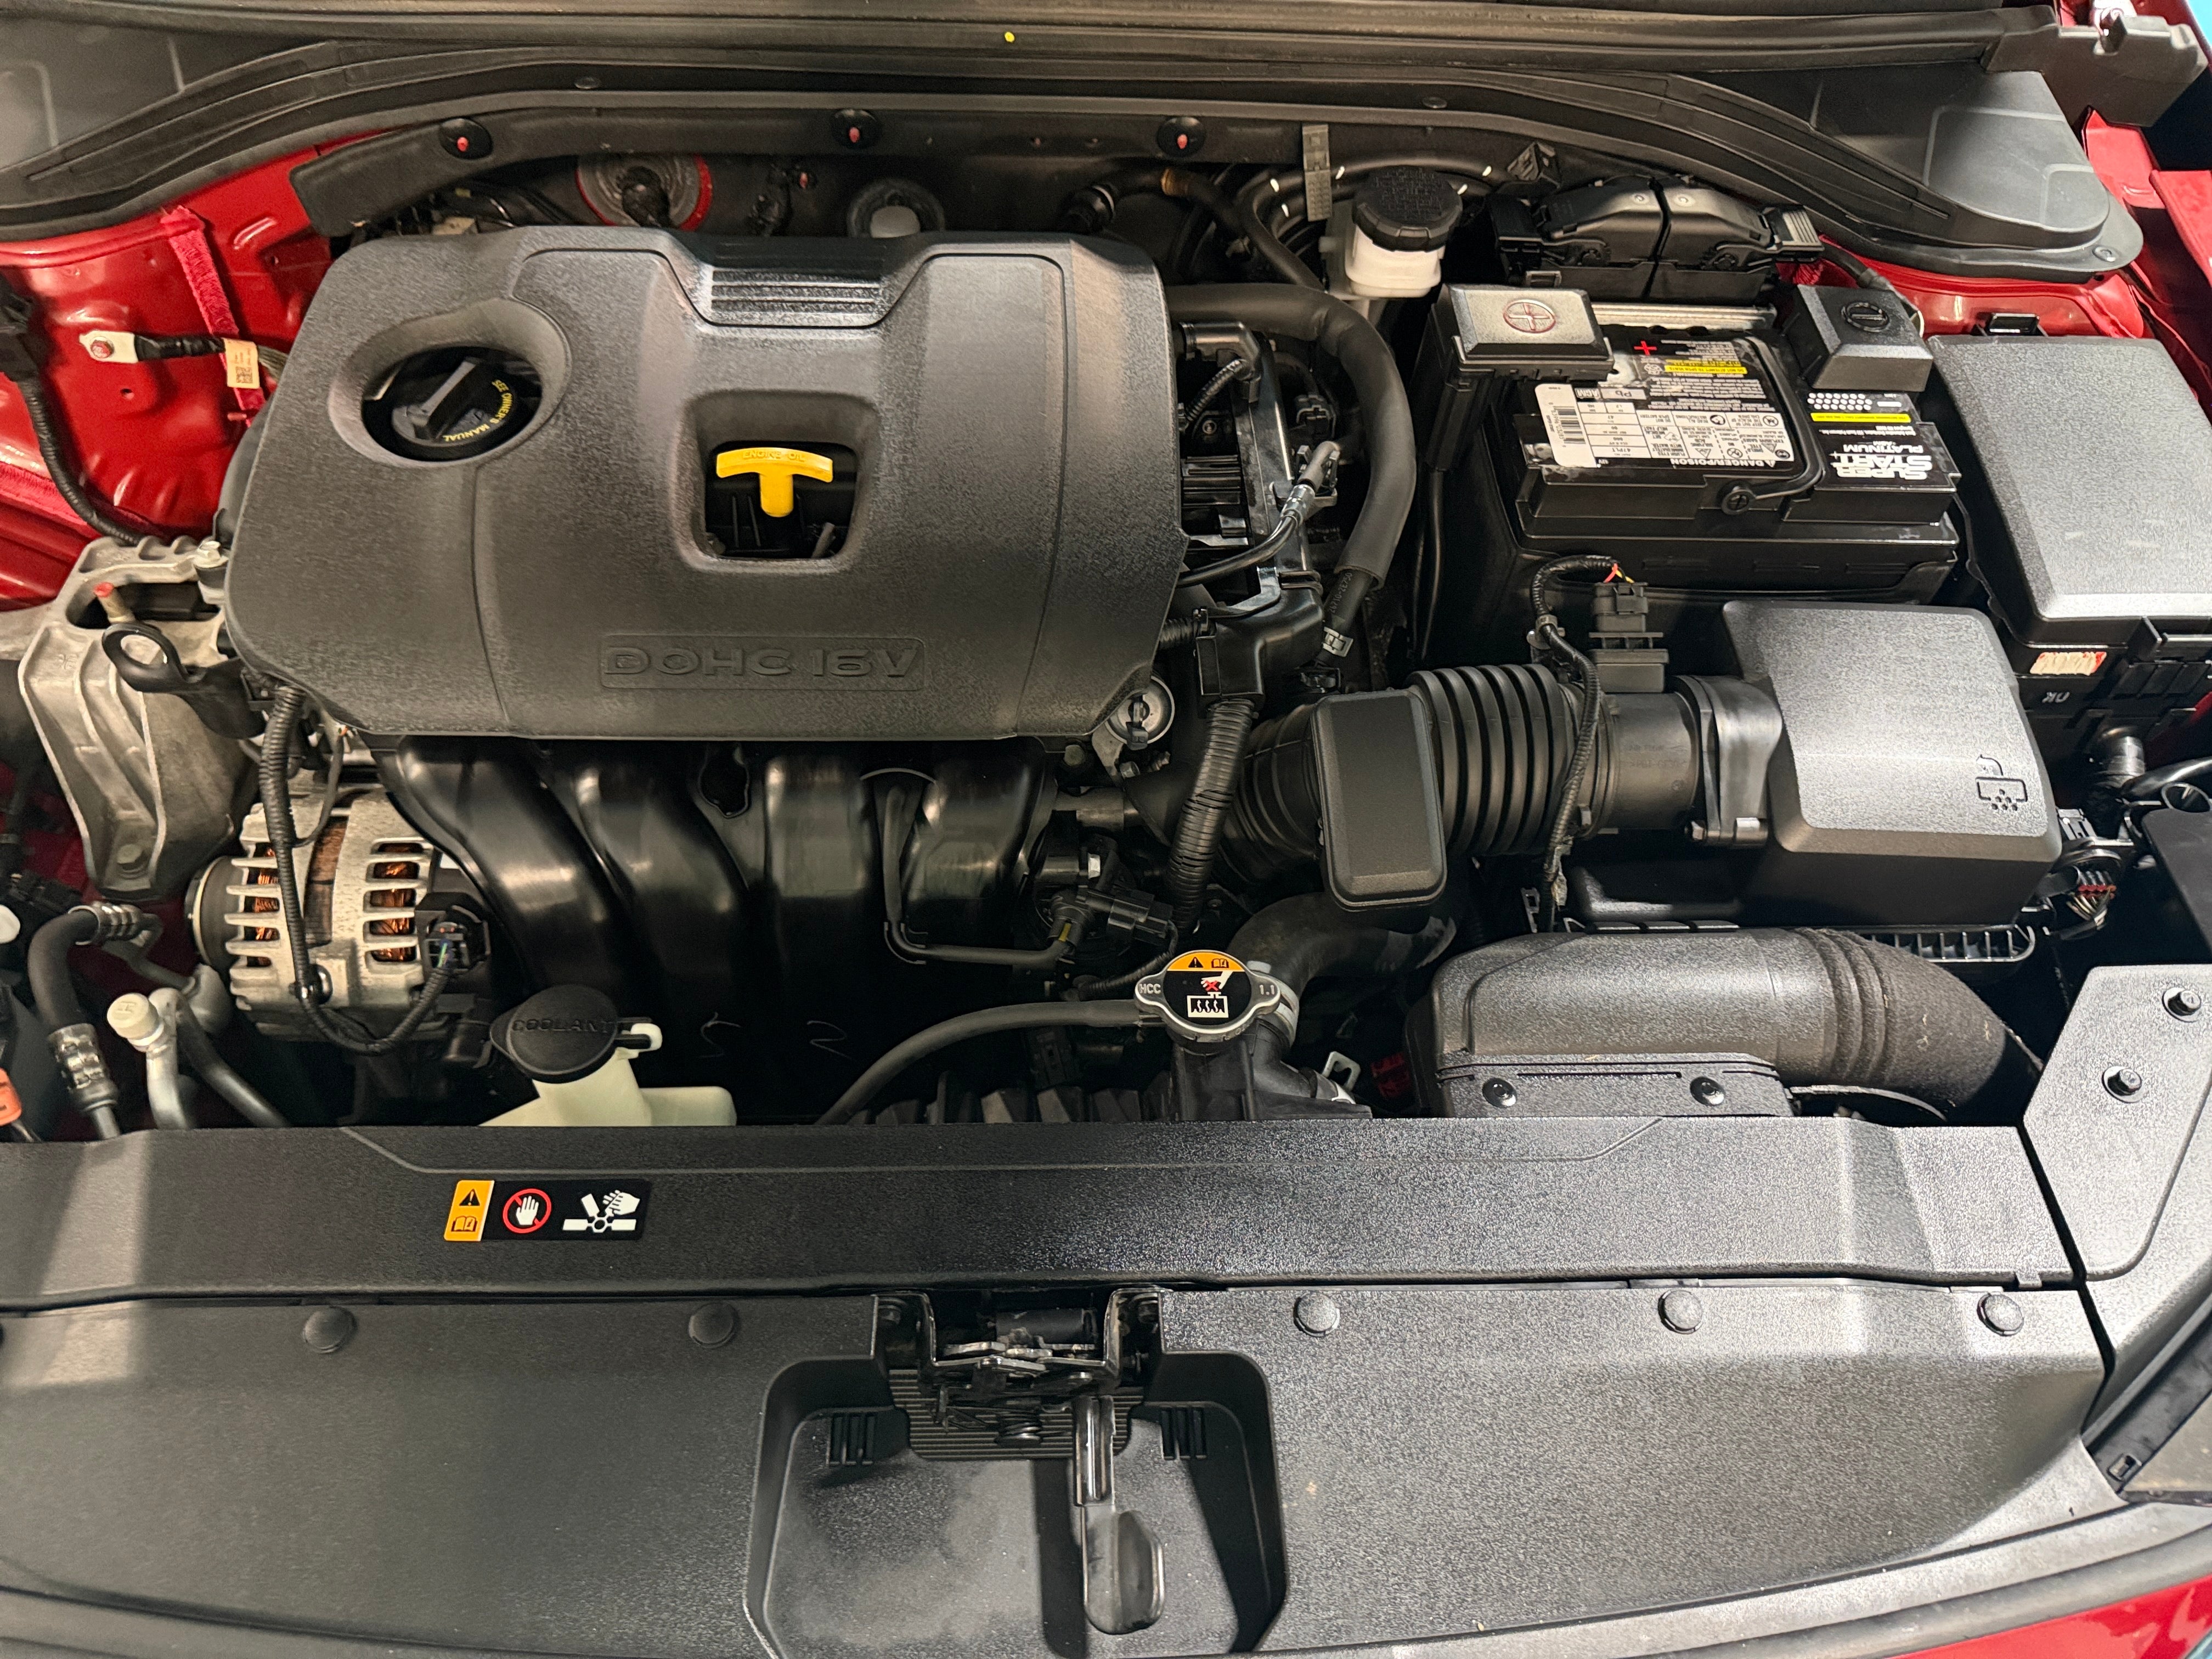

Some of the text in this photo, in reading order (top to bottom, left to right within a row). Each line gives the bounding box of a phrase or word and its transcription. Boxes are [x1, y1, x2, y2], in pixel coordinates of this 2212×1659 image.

[1576, 389, 1598, 398] AGM
[442, 379, 515, 442] SEE OWNER'S MANUAL
[1843, 444, 1924, 453] PLATINUM
[741, 449, 806, 462] ENGINE OIL
[1671, 458, 1764, 467] DANGER/POISON
[1830, 455, 1932, 471] START
[1836, 467, 1927, 480] SUPER
[602, 646, 918, 678] DOHC 16V
[1138, 983, 1276, 996] HCC 1.1
[511, 1018, 614, 1034] COOLANT
